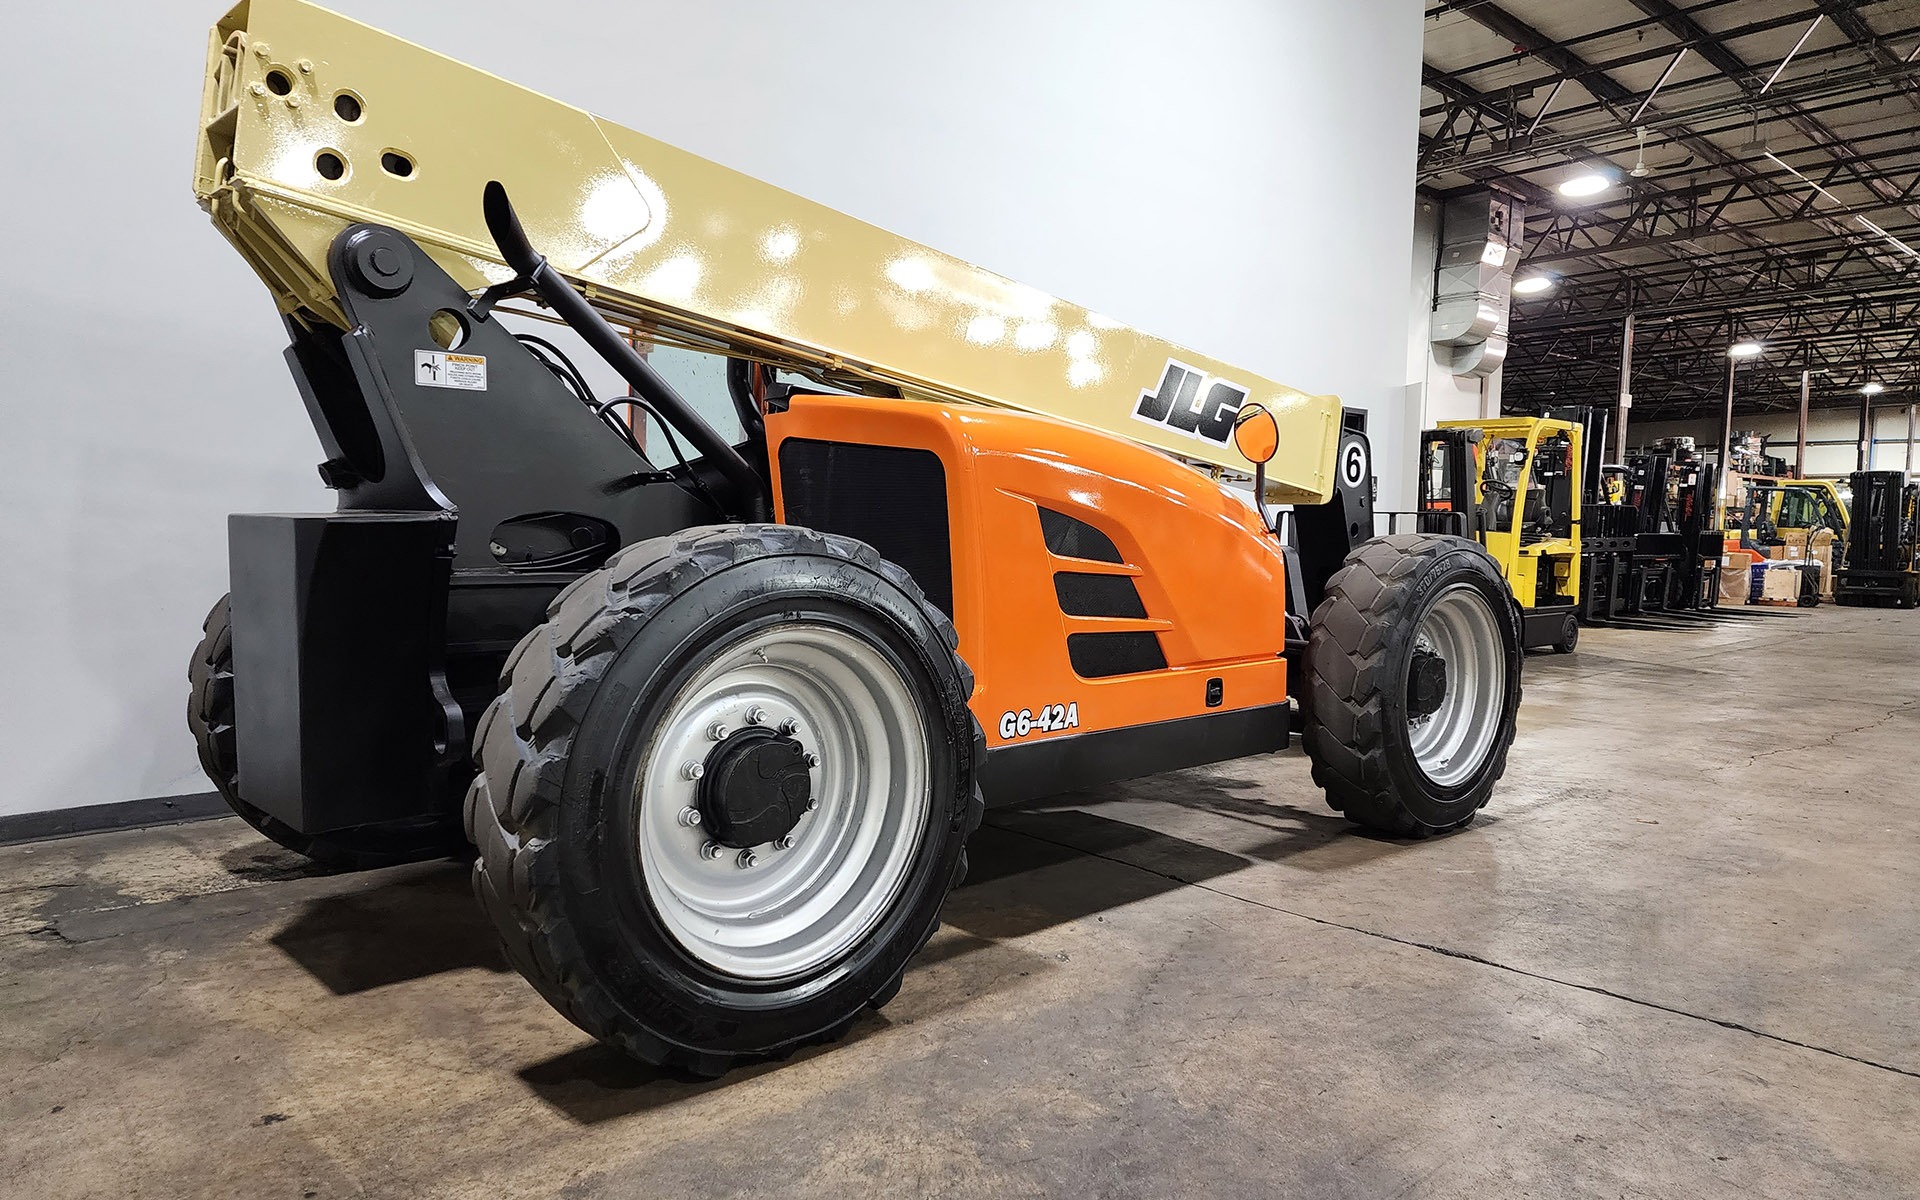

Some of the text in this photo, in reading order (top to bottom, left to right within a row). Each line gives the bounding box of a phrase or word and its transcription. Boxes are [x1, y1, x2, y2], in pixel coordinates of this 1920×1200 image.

[454, 356, 483, 364] WARNING
[1135, 362, 1248, 445] JLG
[1345, 447, 1362, 483] 6
[1416, 559, 1451, 597] 370/75-28
[999, 702, 1079, 739] G6-42A
